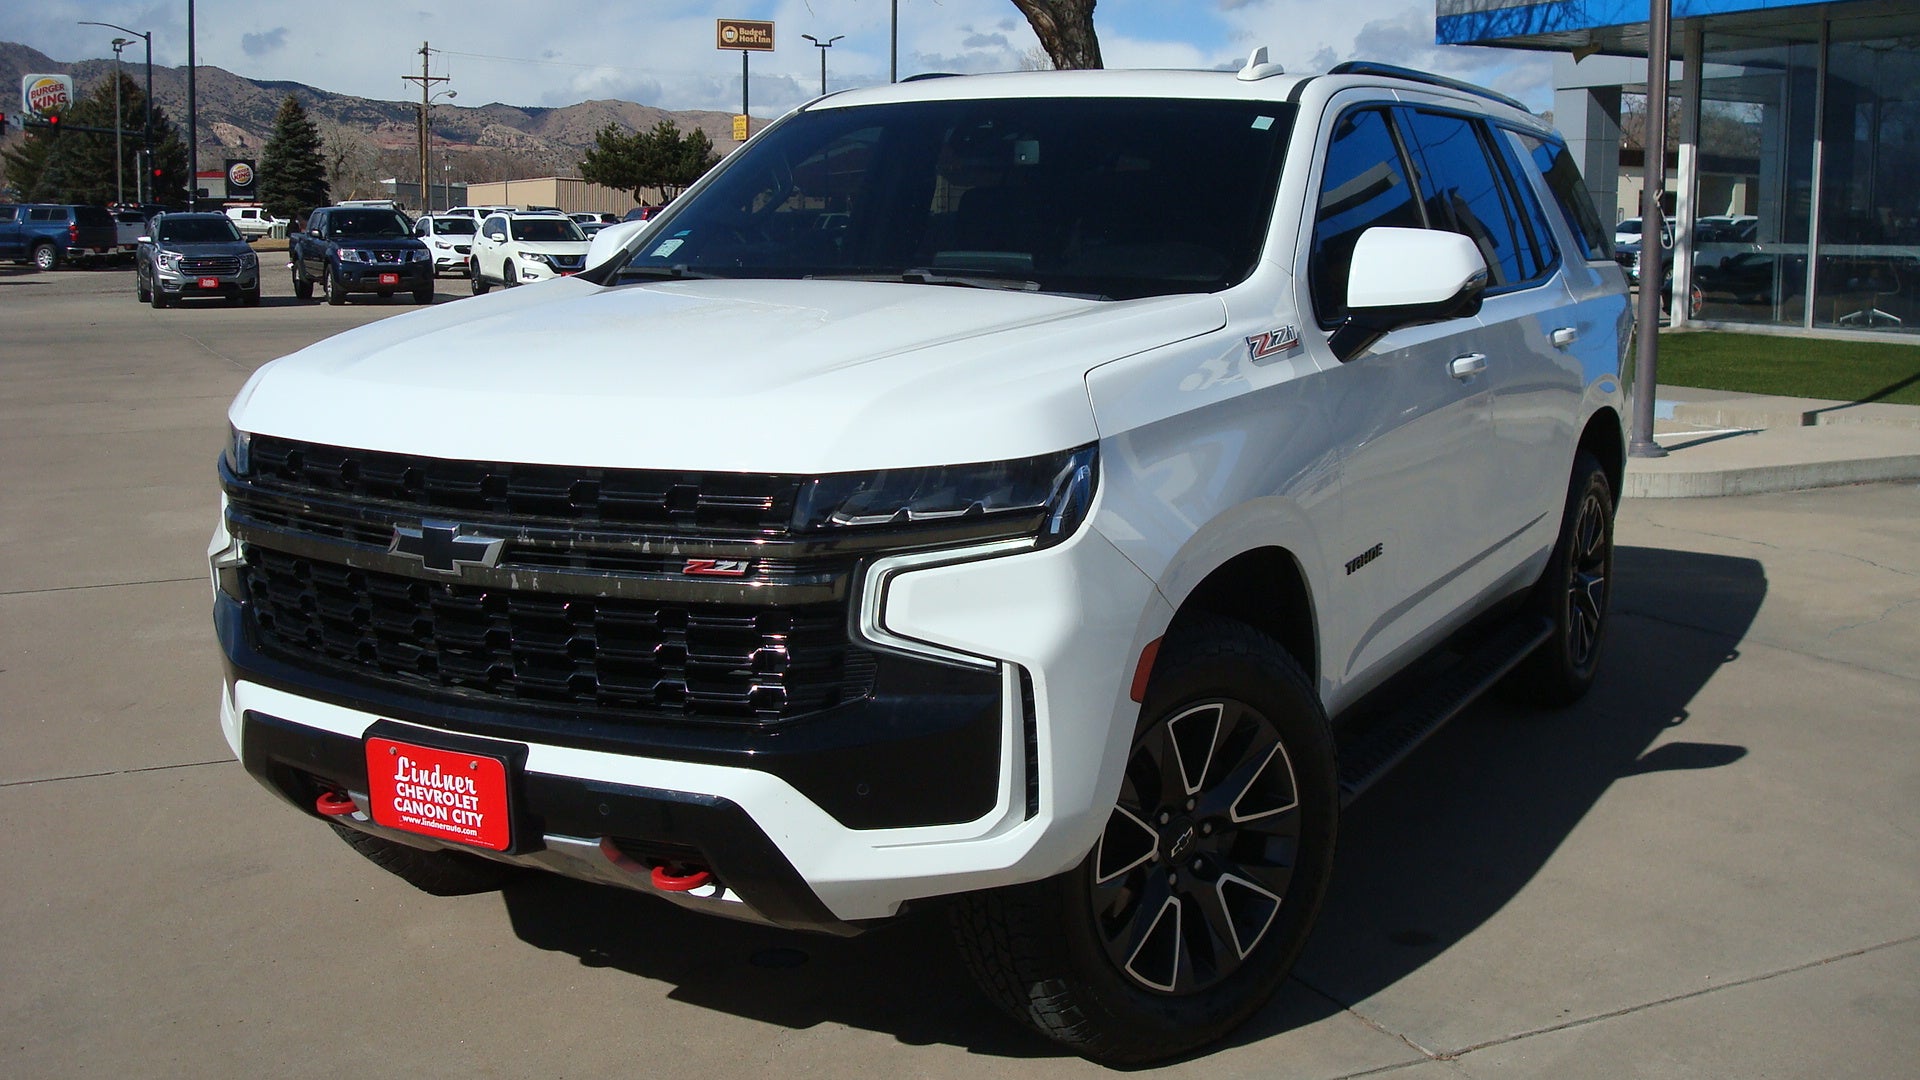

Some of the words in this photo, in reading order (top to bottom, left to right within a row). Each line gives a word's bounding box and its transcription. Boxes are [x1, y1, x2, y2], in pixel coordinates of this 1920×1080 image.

[739, 27, 766, 36] Budget
[739, 35, 757, 43] Host
[31, 83, 64, 98] BURGER
[33, 92, 67, 109] KING
[1245, 325, 1299, 361] Z71
[682, 559, 749, 576] Z71
[394, 756, 477, 794] Lindner
[396, 783, 479, 811] CHEVROLET
[393, 797, 448, 821] CANON
[451, 808, 484, 828] CITY
[402, 815, 478, 836] www.lindnerauto.com
